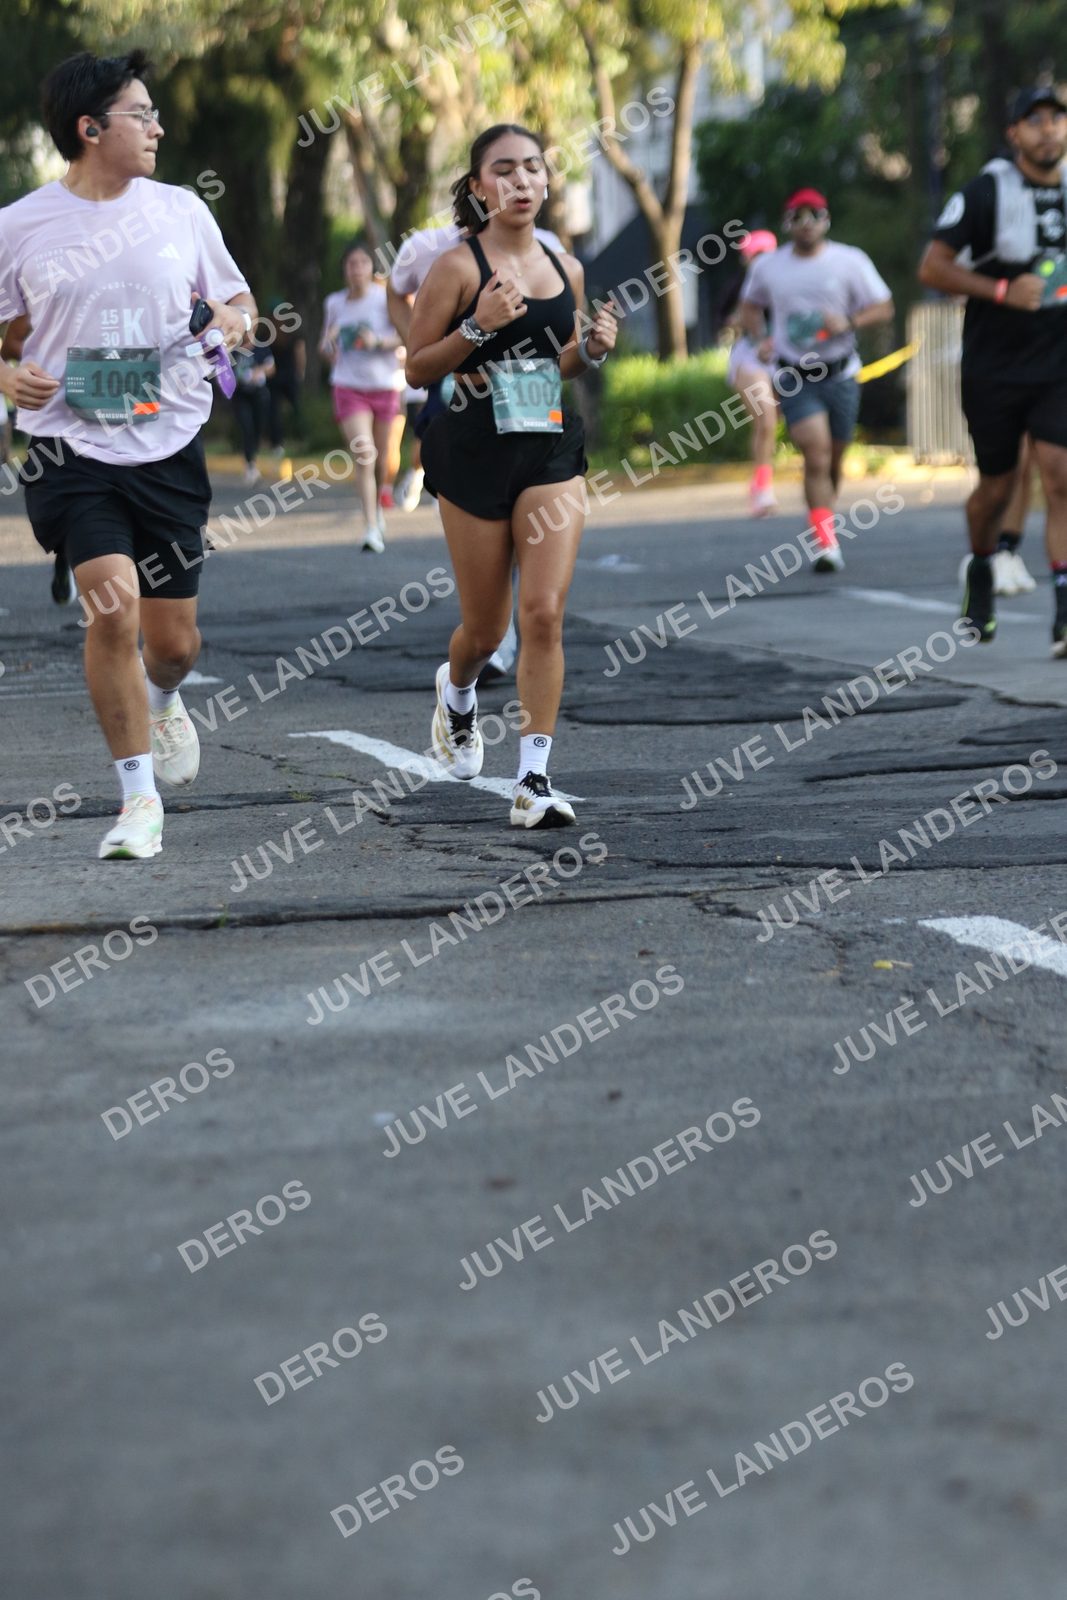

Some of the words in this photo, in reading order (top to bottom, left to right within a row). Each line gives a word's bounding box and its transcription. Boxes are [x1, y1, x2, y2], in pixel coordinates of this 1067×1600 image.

[101, 309, 119, 325] 15
[123, 308, 148, 346] K
[101, 331, 119, 346] 30
